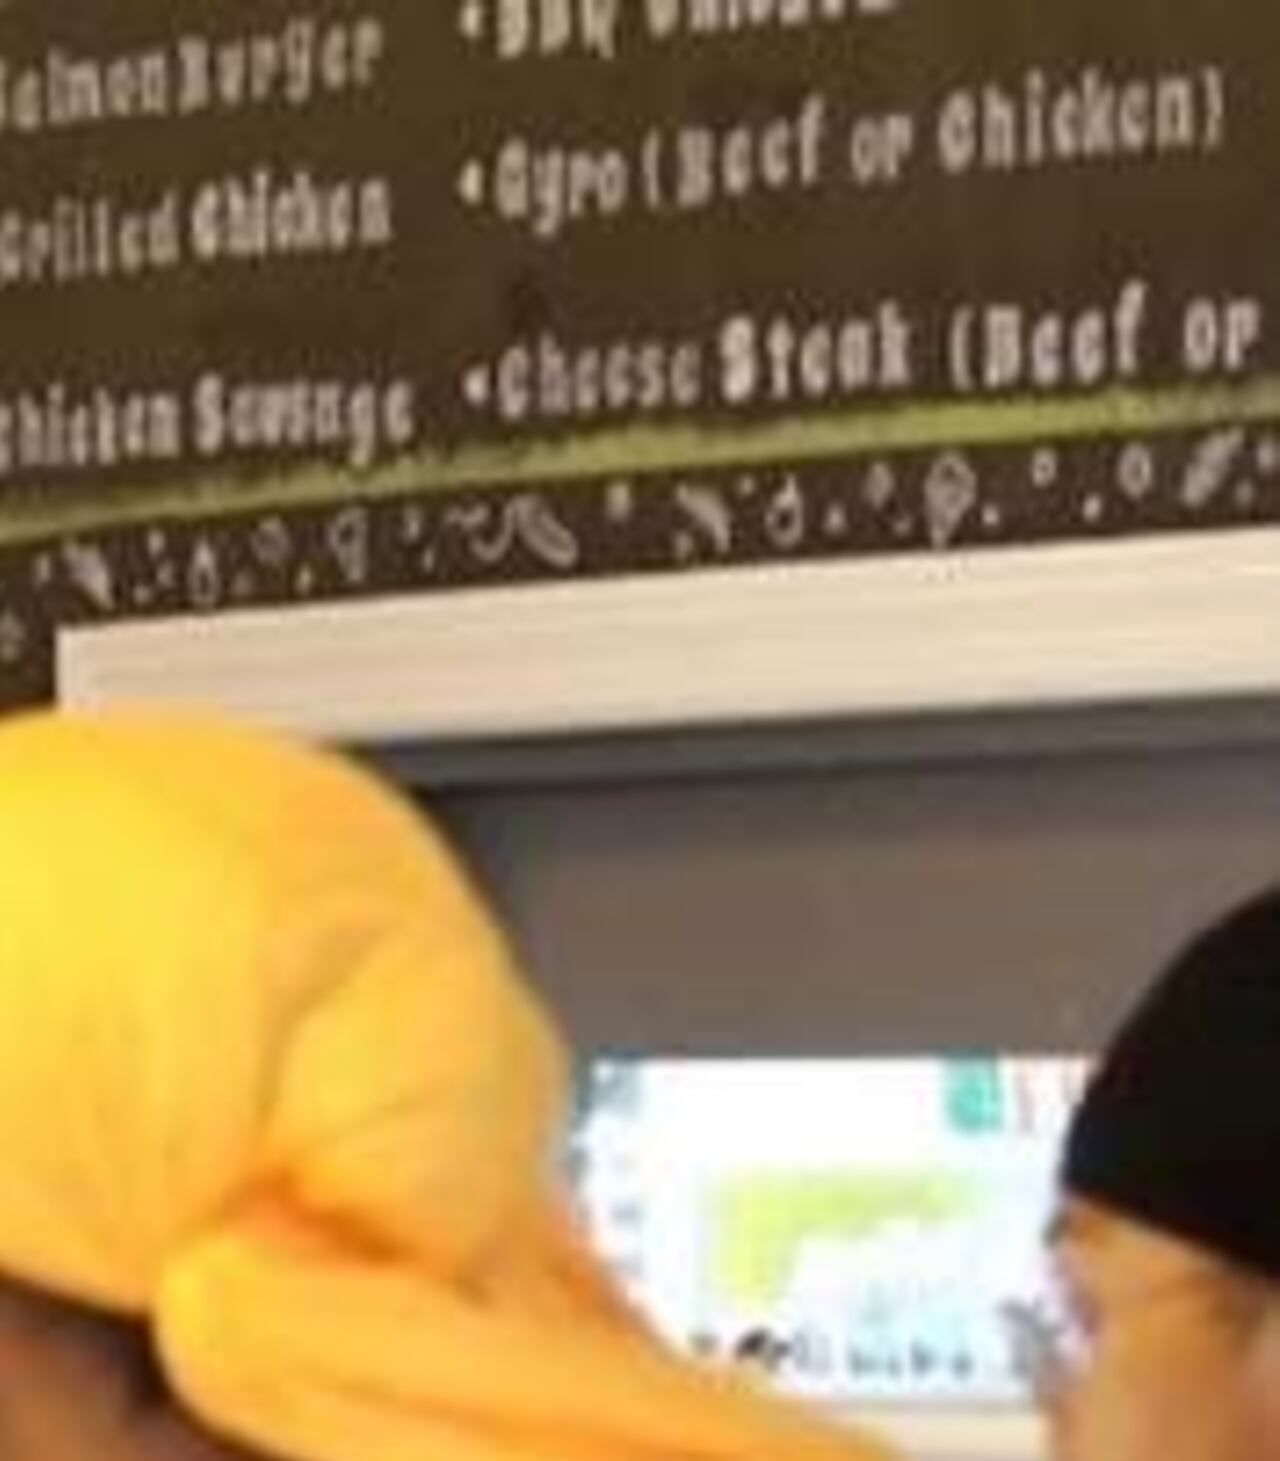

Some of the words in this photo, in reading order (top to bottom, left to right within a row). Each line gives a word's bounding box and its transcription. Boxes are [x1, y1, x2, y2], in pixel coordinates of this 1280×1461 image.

[850, 114, 915, 186] or
[948, 276, 1148, 391] (Beef
[1184, 297, 1260, 373] or
